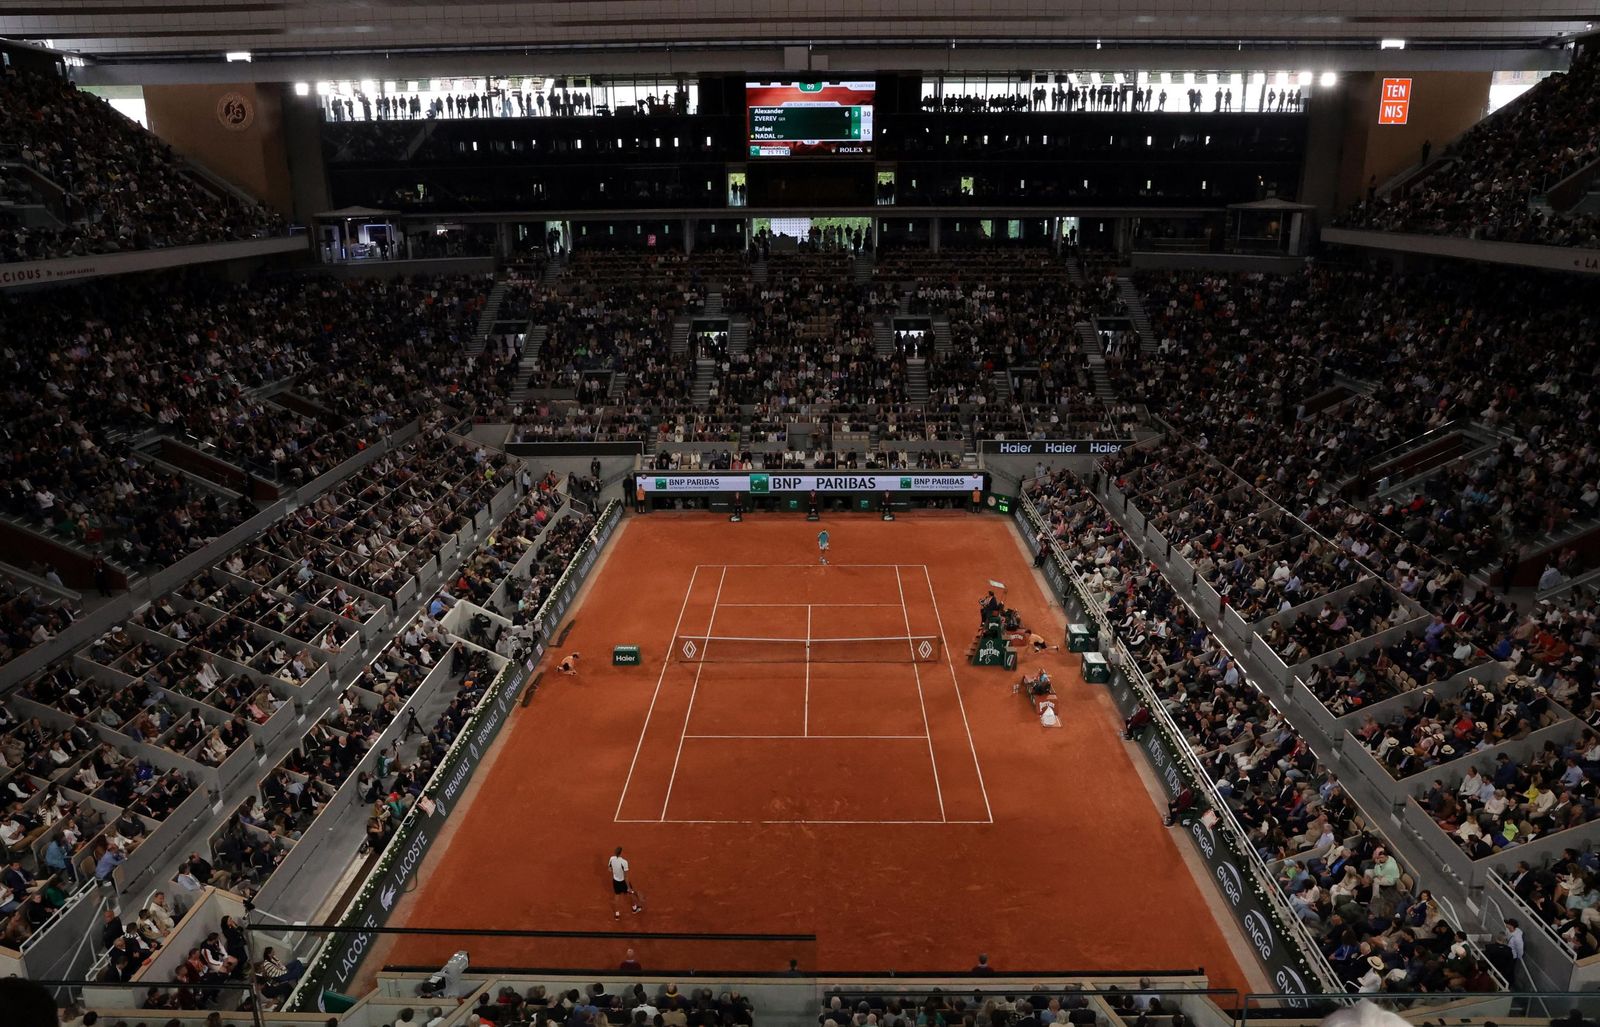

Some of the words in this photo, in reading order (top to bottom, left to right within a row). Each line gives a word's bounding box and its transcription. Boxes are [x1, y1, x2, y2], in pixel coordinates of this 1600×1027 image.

[1386, 85, 1406, 97] TEN
[1384, 106, 1403, 118] NIS
[0, 269, 40, 283] CIOUS
[1000, 443, 1032, 453] Haier
[1045, 443, 1077, 453] Haier
[1090, 443, 1121, 453] Haier
[772, 478, 801, 489] BNP
[816, 477, 876, 489] PARIBAS
[504, 670, 524, 700] RENAULT
[477, 710, 499, 746] RENAULT
[444, 757, 470, 800] RENAULT
[394, 830, 428, 886] LACOSTE
[335, 914, 377, 983] LACOSTE
